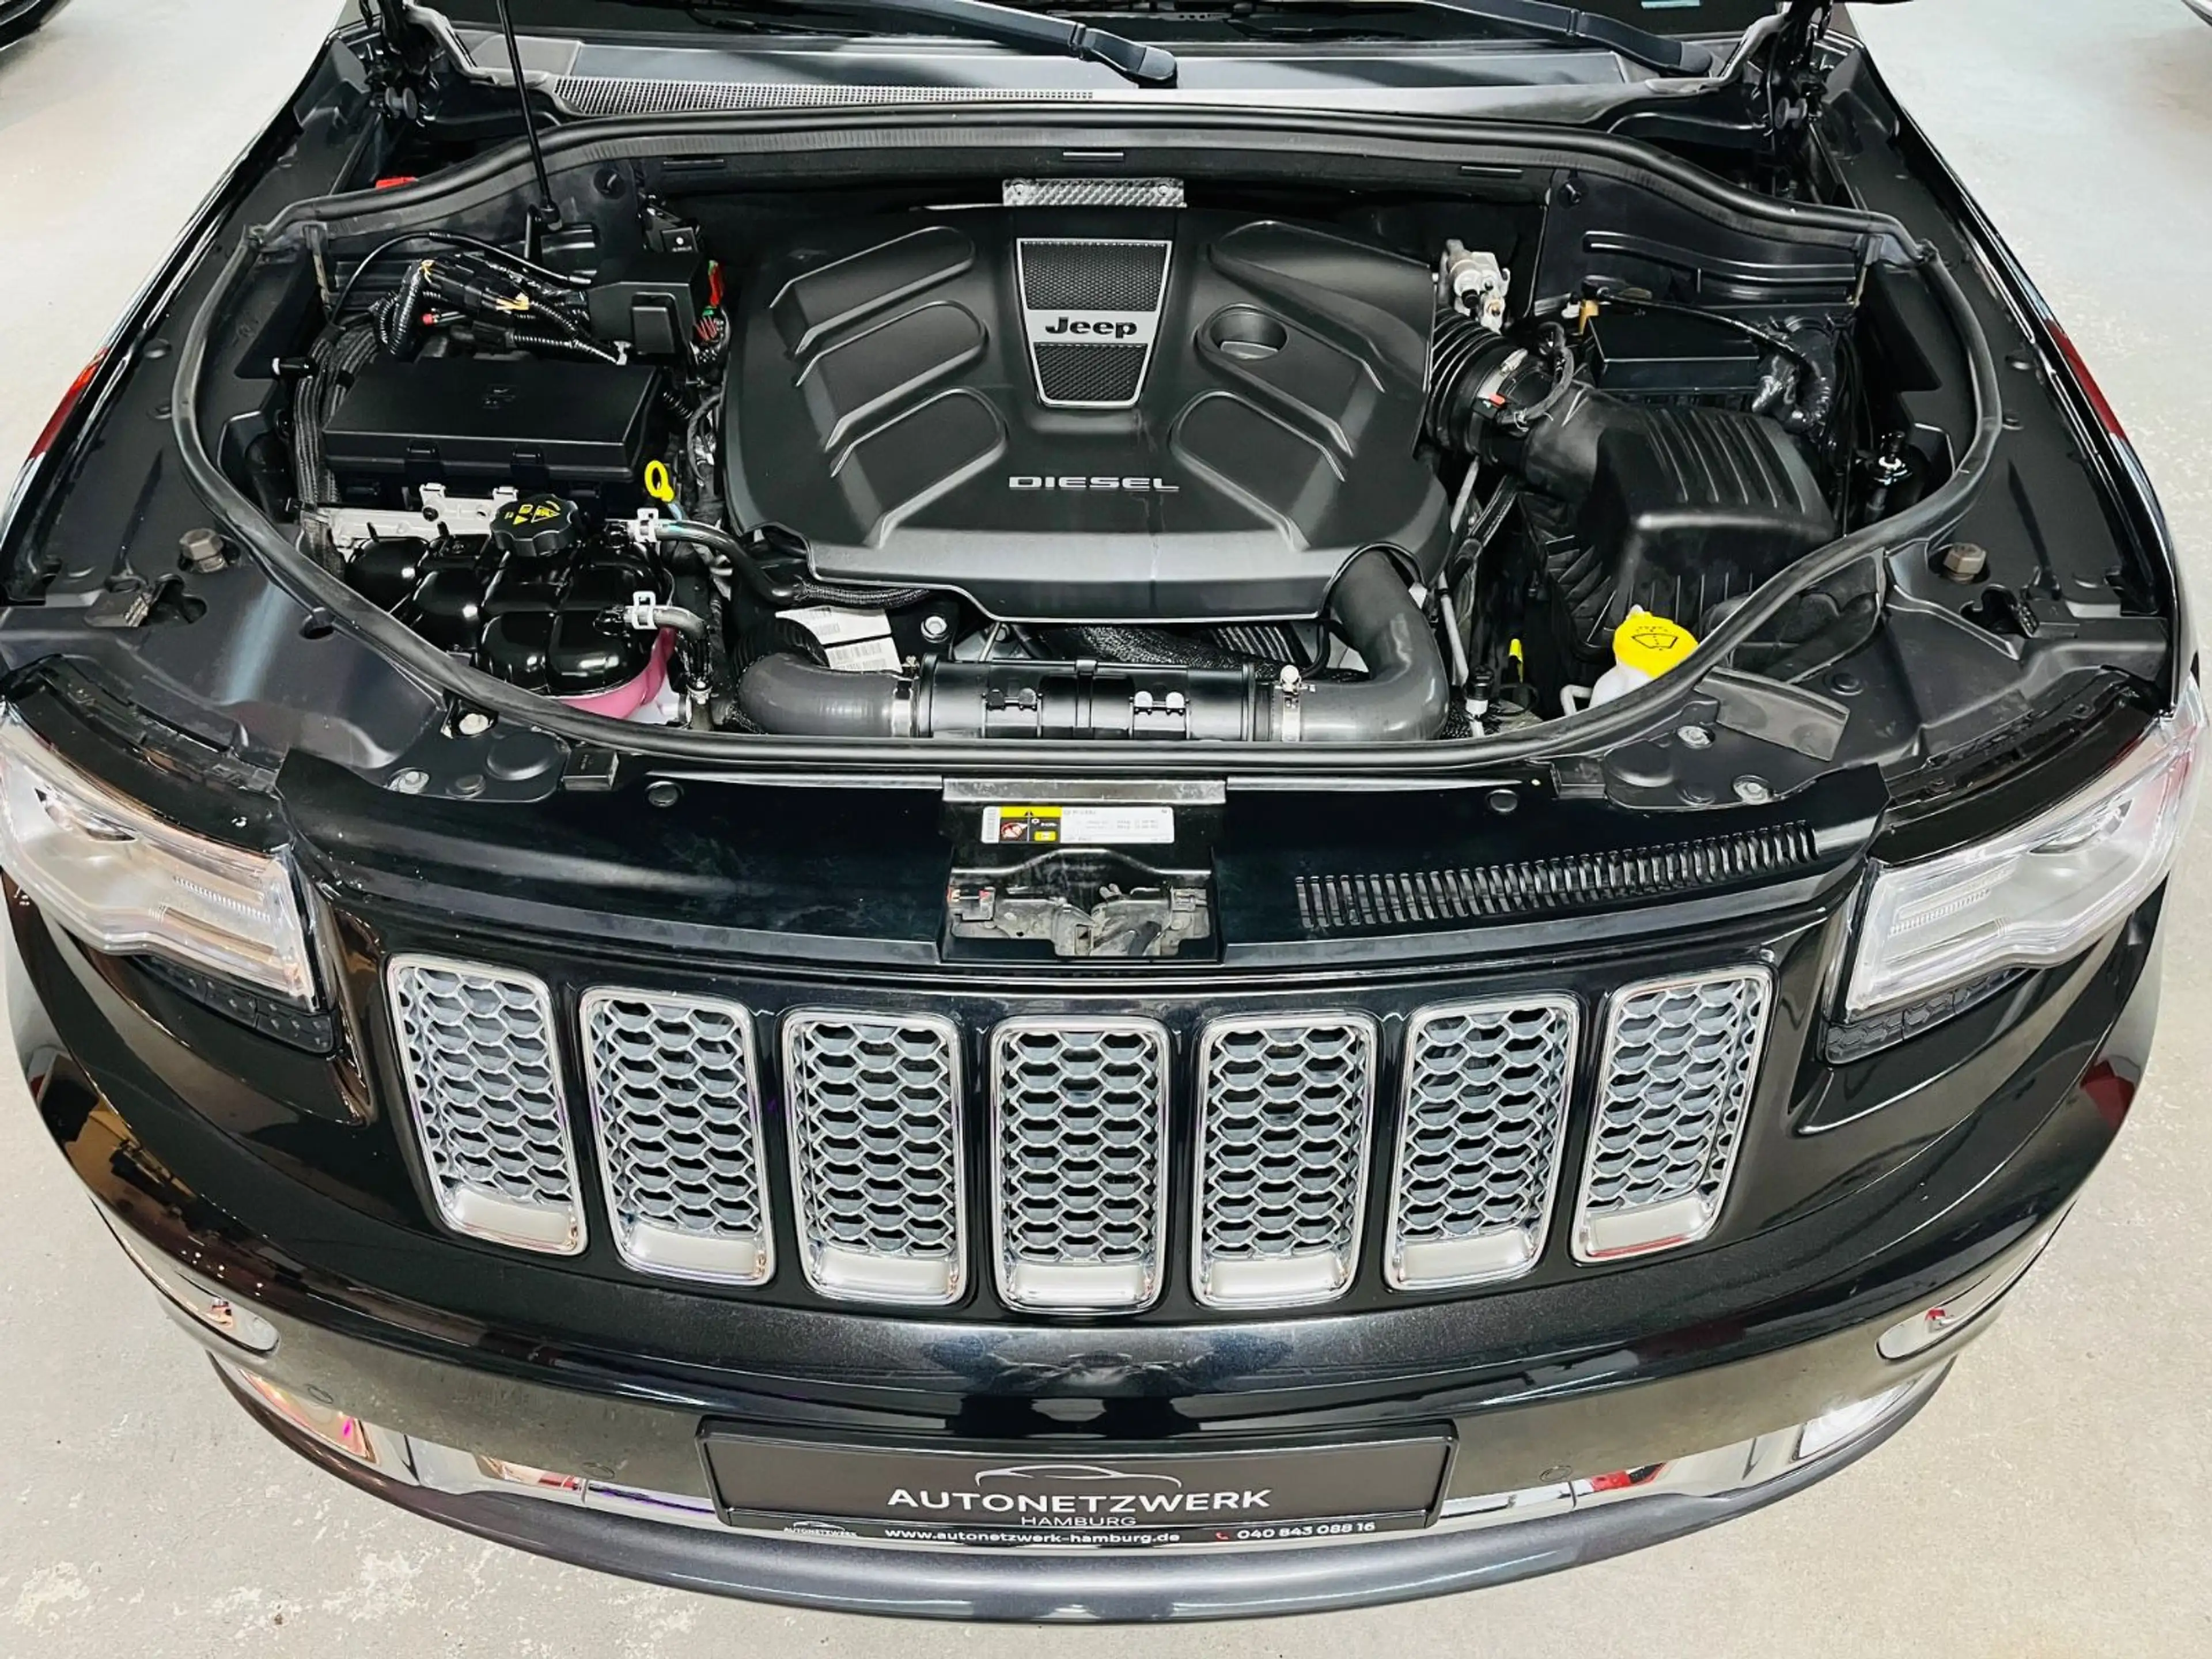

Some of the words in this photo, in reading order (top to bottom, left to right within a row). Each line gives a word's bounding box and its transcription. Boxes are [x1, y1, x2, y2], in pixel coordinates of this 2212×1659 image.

[1045, 316, 1137, 339] Jeep
[1009, 476, 1180, 492] DIESEL
[887, 1488, 1273, 1513] AUTONETZWERK
[1021, 1516, 1137, 1527] HAMBURG
[884, 1528, 1180, 1544] www.autonetzwerk-hamburg.de
[1237, 1529, 1275, 1540] 040
[1278, 1525, 1313, 1537] 843
[1316, 1524, 1353, 1535] 088
[1357, 1521, 1376, 1532] 16
